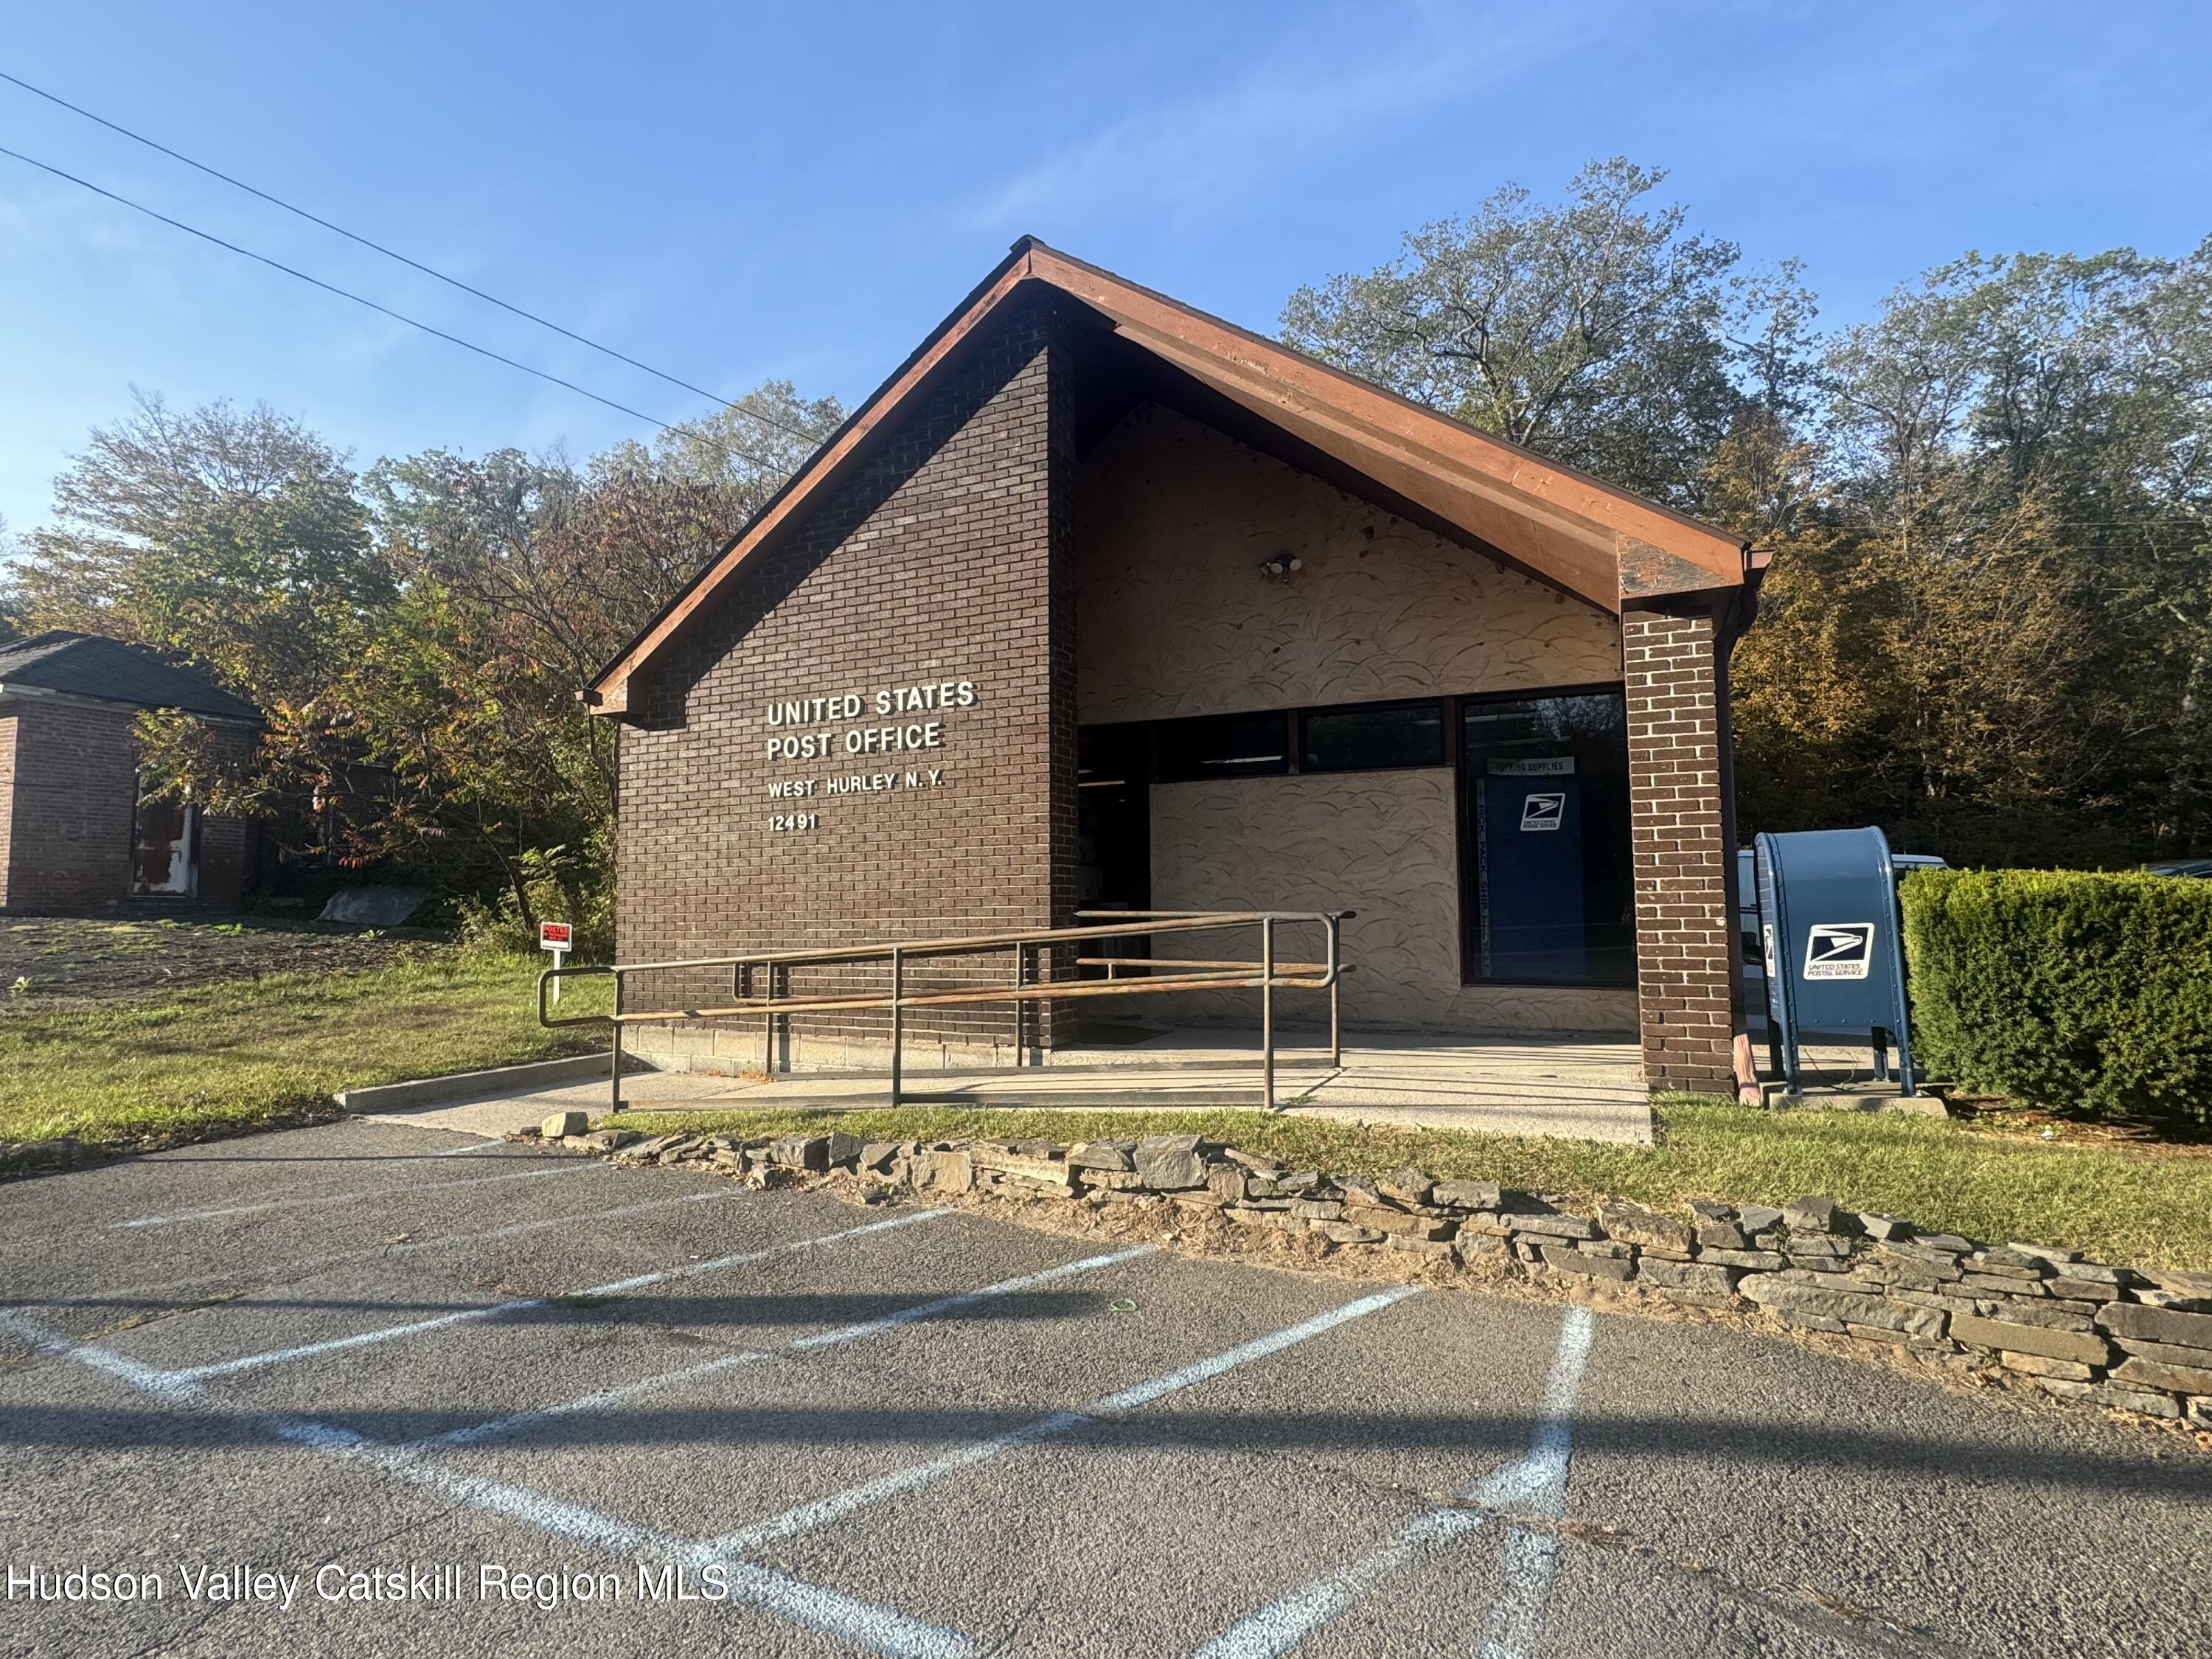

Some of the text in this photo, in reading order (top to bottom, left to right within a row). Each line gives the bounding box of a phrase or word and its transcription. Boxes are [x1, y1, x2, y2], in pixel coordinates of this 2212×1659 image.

[768, 681, 974, 726] UNITED STATES
[768, 722, 940, 760] POST OFFICE
[1528, 761, 1563, 772] SUPPLIES
[768, 779, 815, 798] WEST
[827, 773, 895, 794] HURLEY
[768, 813, 815, 831] 12491
